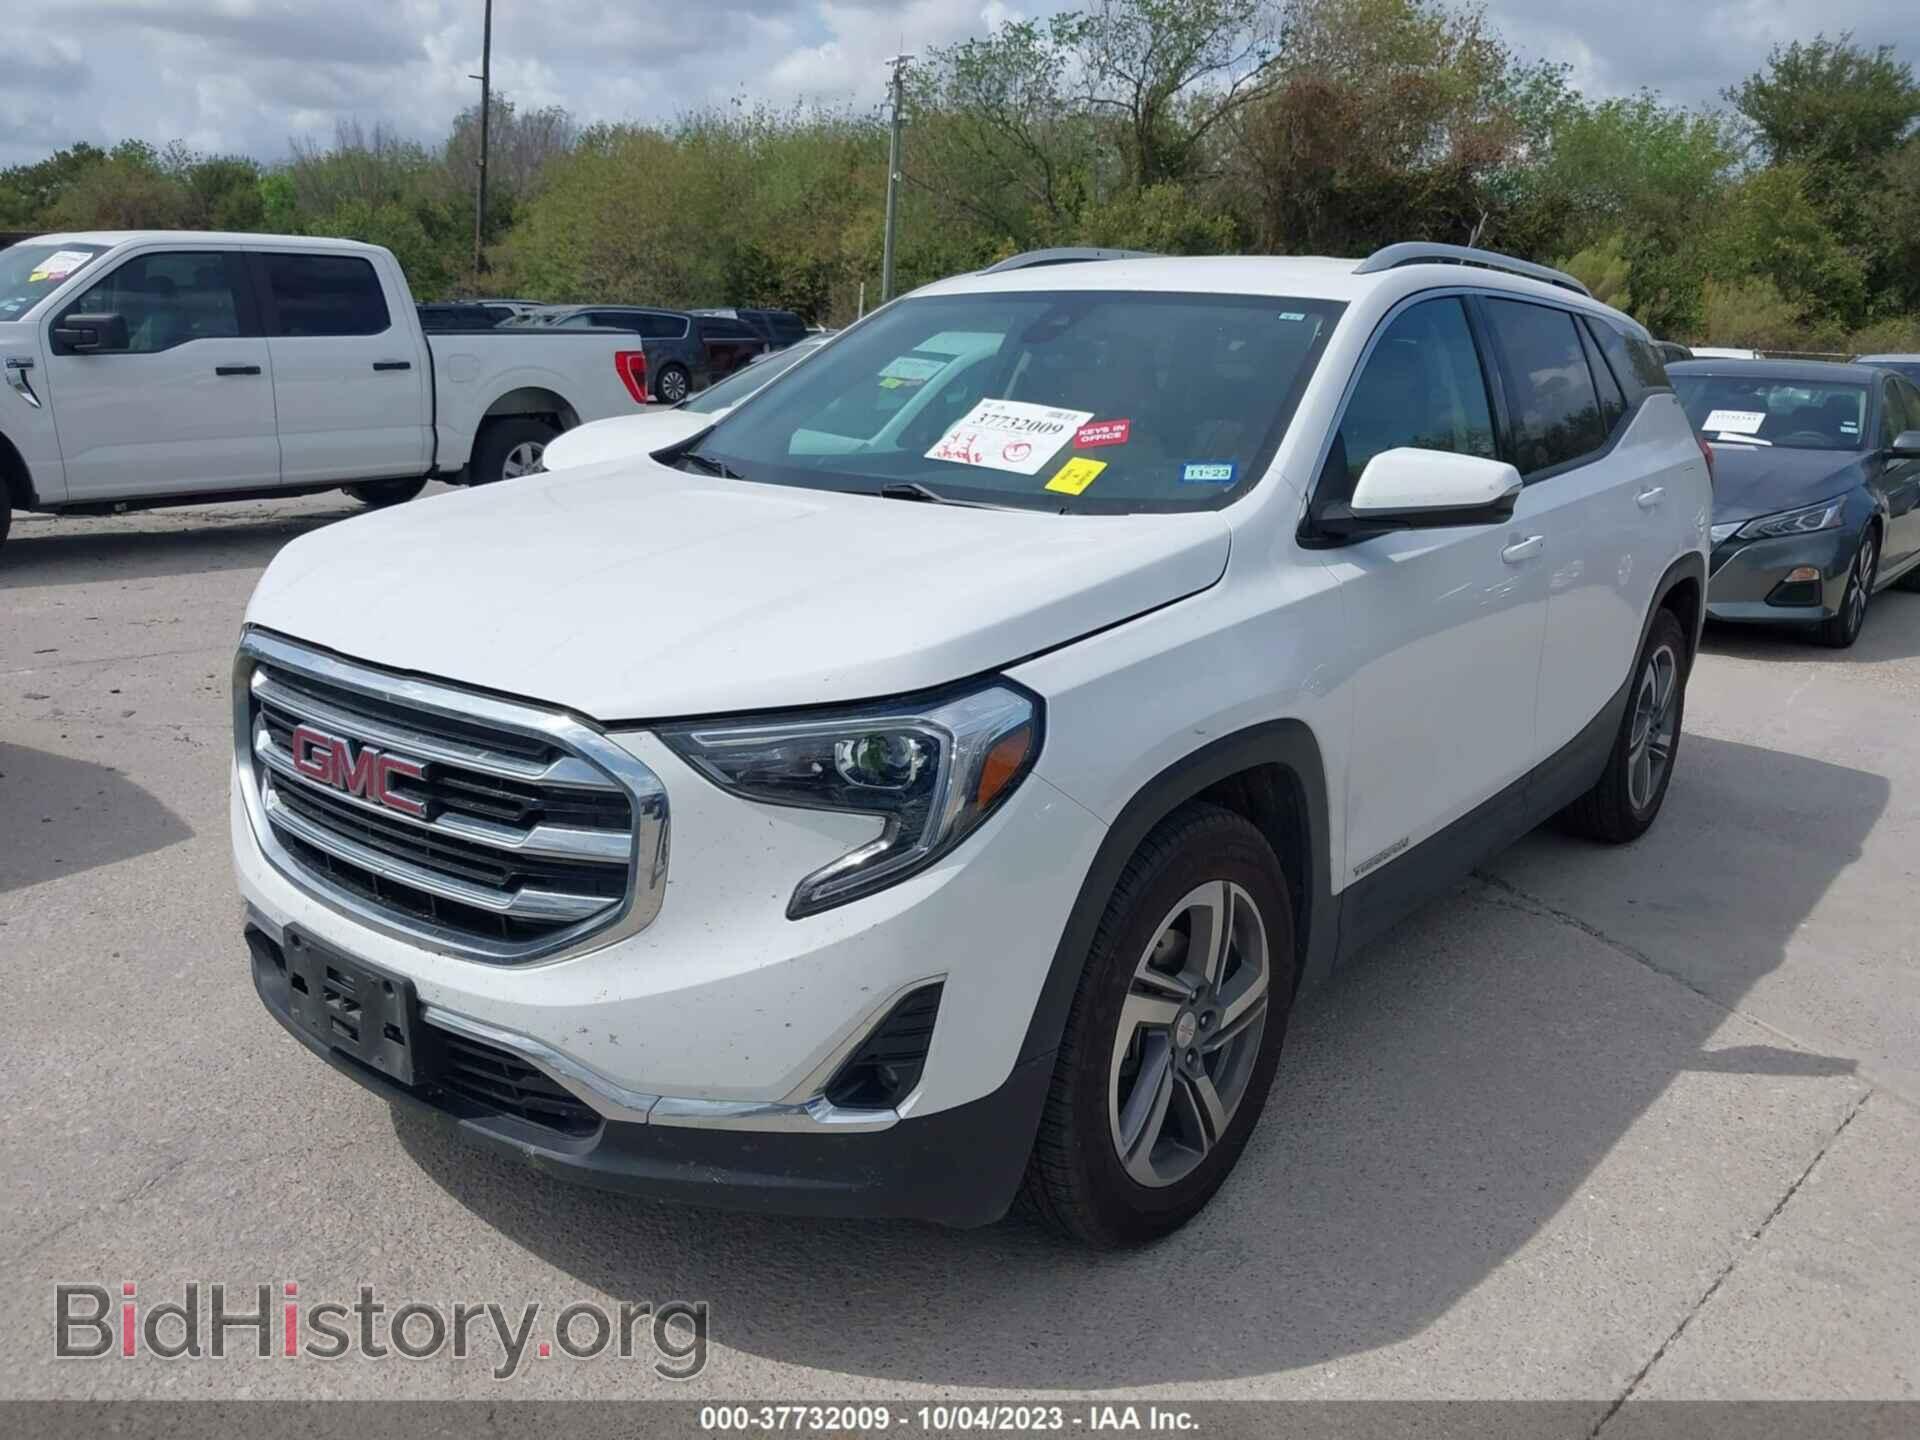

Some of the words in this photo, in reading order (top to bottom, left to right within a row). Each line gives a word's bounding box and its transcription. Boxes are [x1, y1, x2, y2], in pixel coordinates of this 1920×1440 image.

[971, 412, 1064, 434] 37732009
[1079, 426, 1109, 436] KEYS
[1113, 423, 1126, 432] IN
[1081, 431, 1121, 443] OFFICE
[292, 724, 429, 819] GMC
